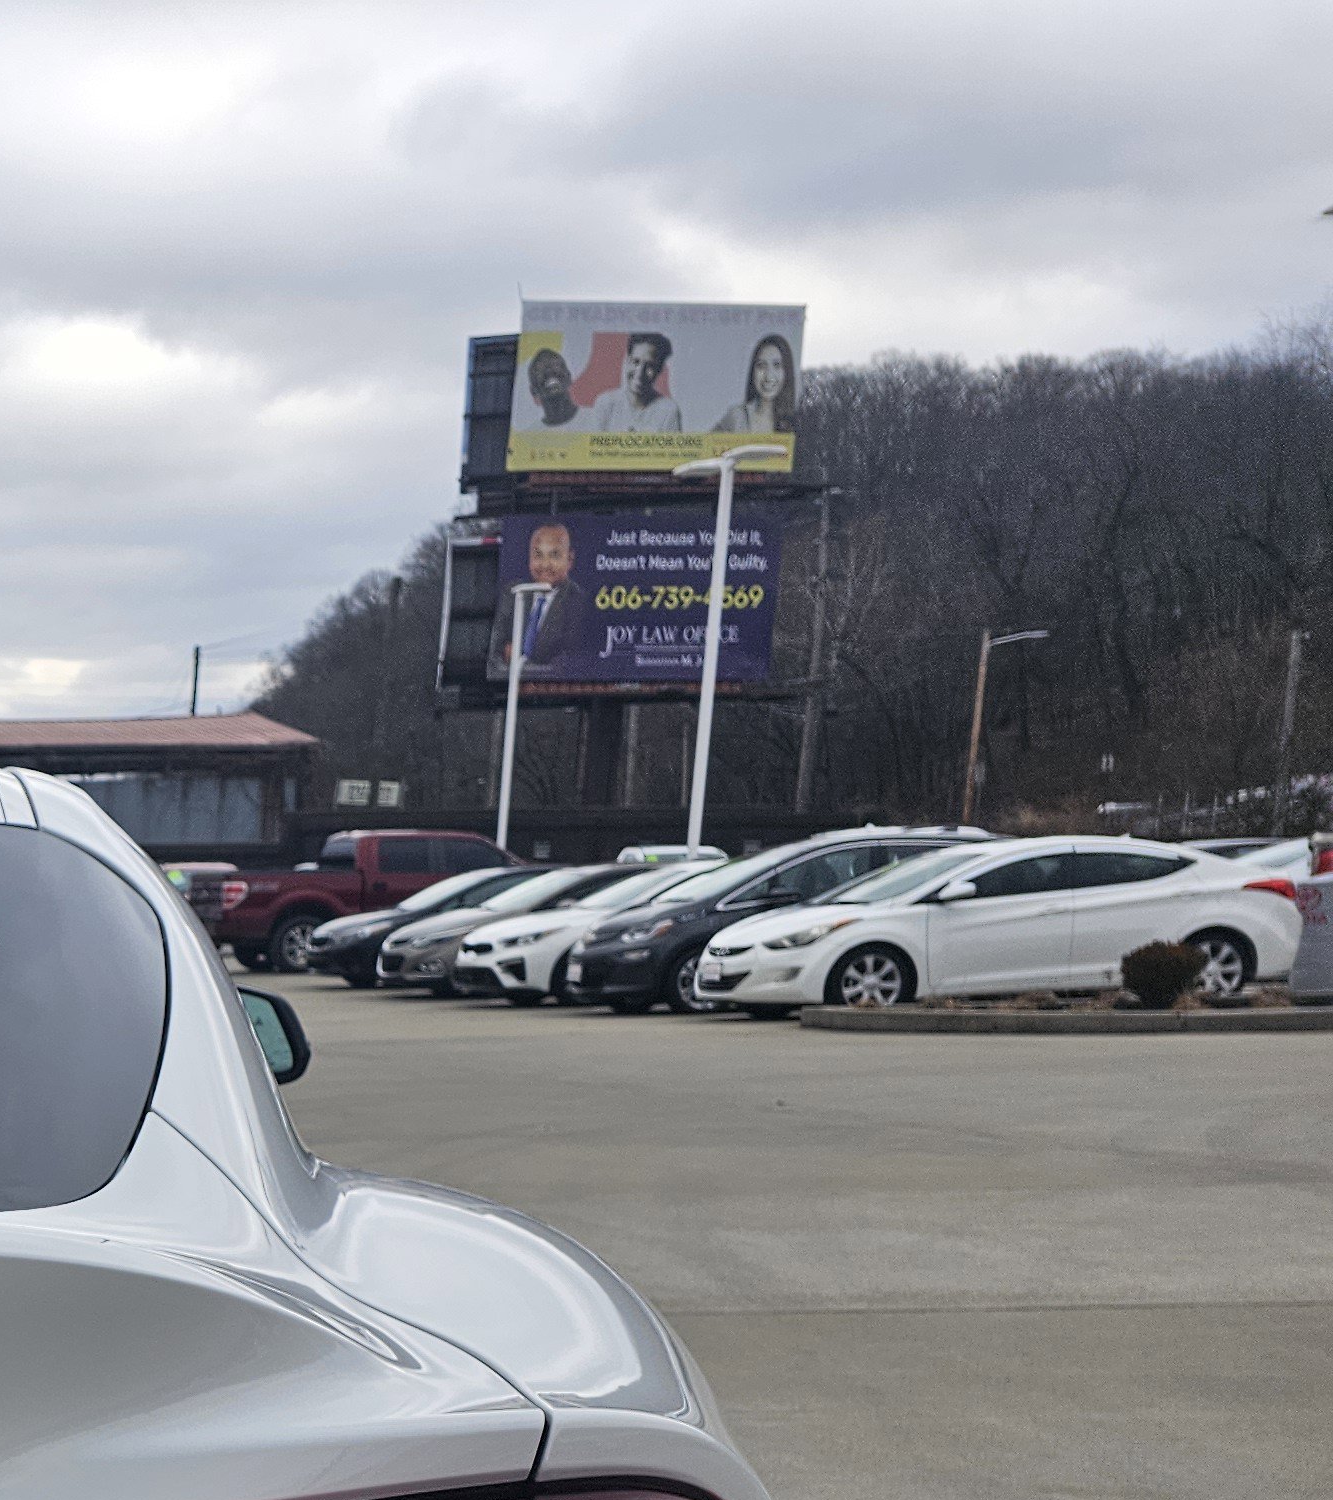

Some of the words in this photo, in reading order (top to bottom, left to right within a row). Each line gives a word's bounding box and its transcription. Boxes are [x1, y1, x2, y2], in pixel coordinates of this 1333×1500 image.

[606, 530, 636, 546] Just
[639, 530, 695, 546] Because
[699, 530, 716, 546] Yo
[596, 554, 645, 570] Doesn't
[648, 554, 684, 570] Mean
[599, 625, 636, 658] JOY
[641, 625, 678, 643] LAW
[683, 625, 739, 643] OFCE
